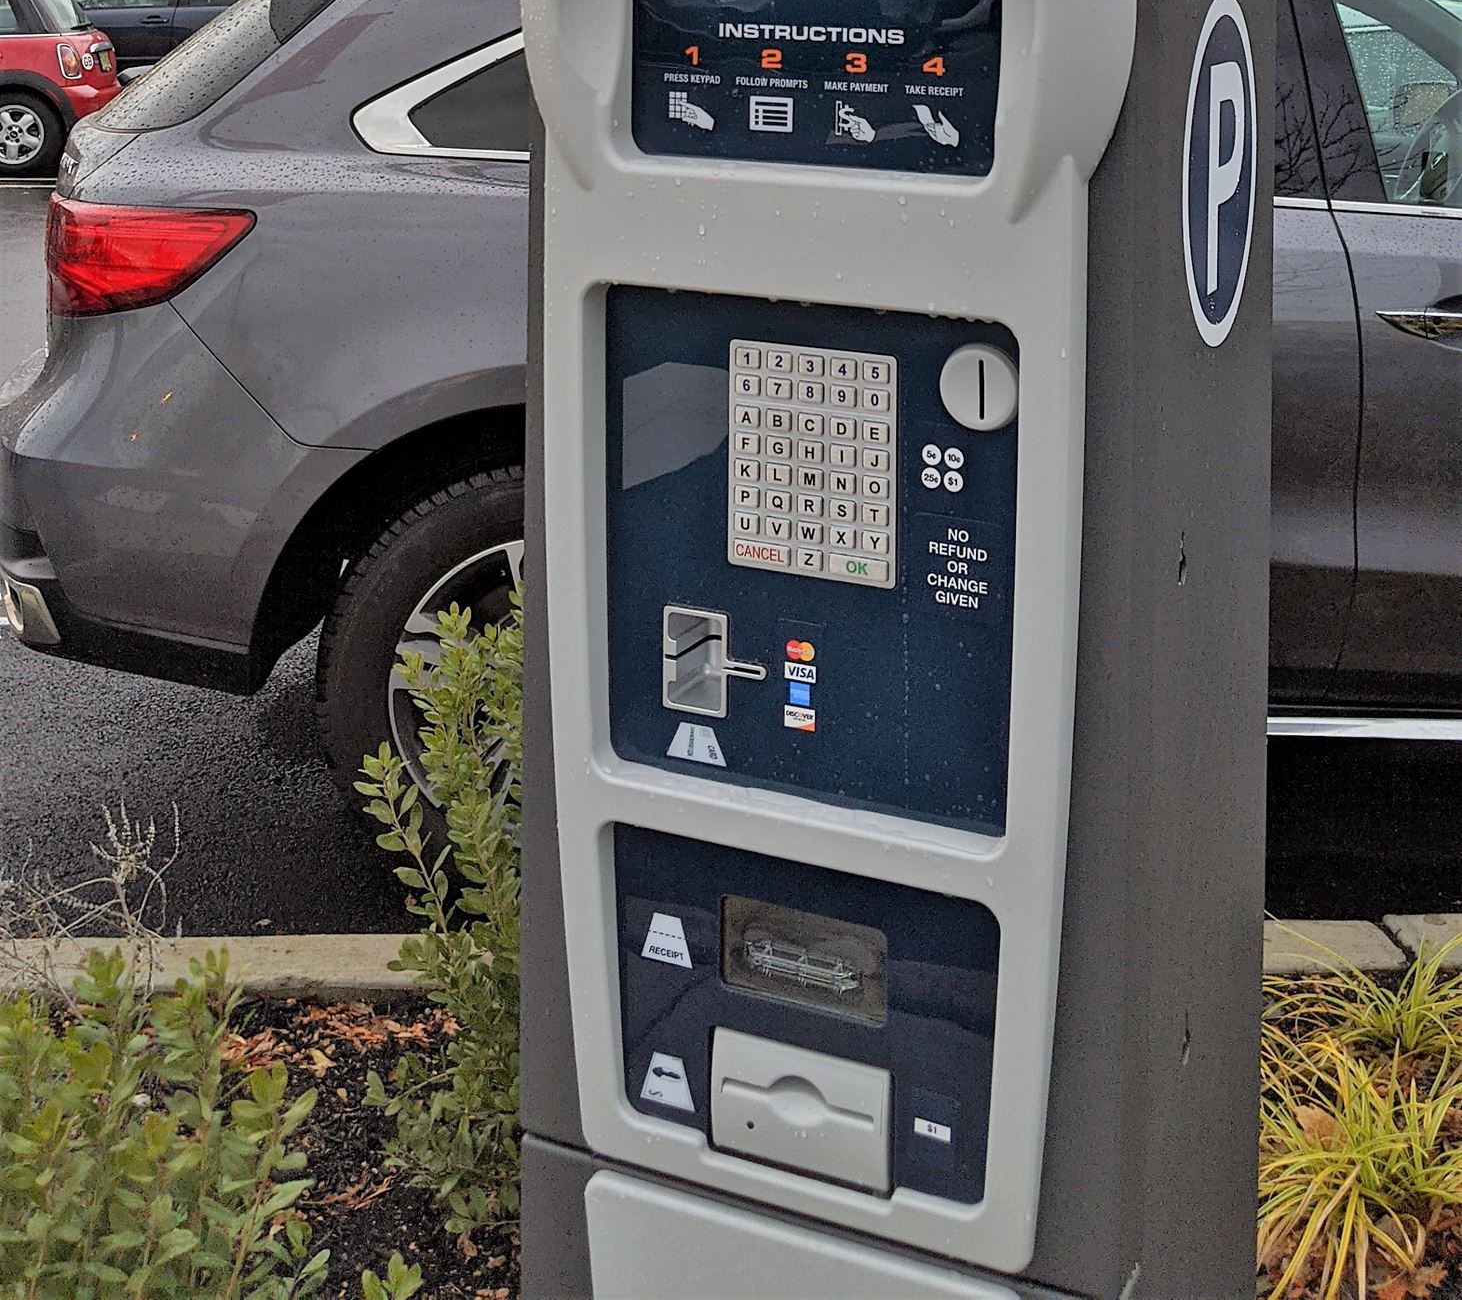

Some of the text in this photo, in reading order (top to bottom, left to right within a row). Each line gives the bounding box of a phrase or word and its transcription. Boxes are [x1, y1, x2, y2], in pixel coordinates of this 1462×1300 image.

[718, 21, 905, 46] INSTRUCTIONS
[684, 45, 946, 77] 1 2 3 4
[663, 72, 722, 85] PRESS KEYPAD
[735, 76, 809, 89] FOLLOW PROMPTS
[824, 80, 889, 94] MAKE PAYMENT
[904, 84, 965, 97] TAKE RECEIPT
[1206, 60, 1246, 297] P
[743, 353, 879, 379] 1 2 3 4 5
[742, 379, 879, 406] 6 7 8 9 0
[741, 411, 879, 440] A B C D E
[741, 438, 879, 468] F G H I J
[741, 465, 881, 494] K L M N O
[947, 476, 958, 486] $1
[741, 491, 879, 521] P Q R S T
[741, 518, 880, 549] U V W X Y
[947, 528, 969, 543] NO
[735, 544, 868, 575] CANCEL Z OK
[929, 541, 988, 562] REFUND
[947, 560, 968, 575] OR
[927, 573, 988, 594] CHANGE
[935, 590, 979, 609] GIVEN
[788, 665, 815, 681] VISA
[648, 944, 684, 961] RECEIPT
